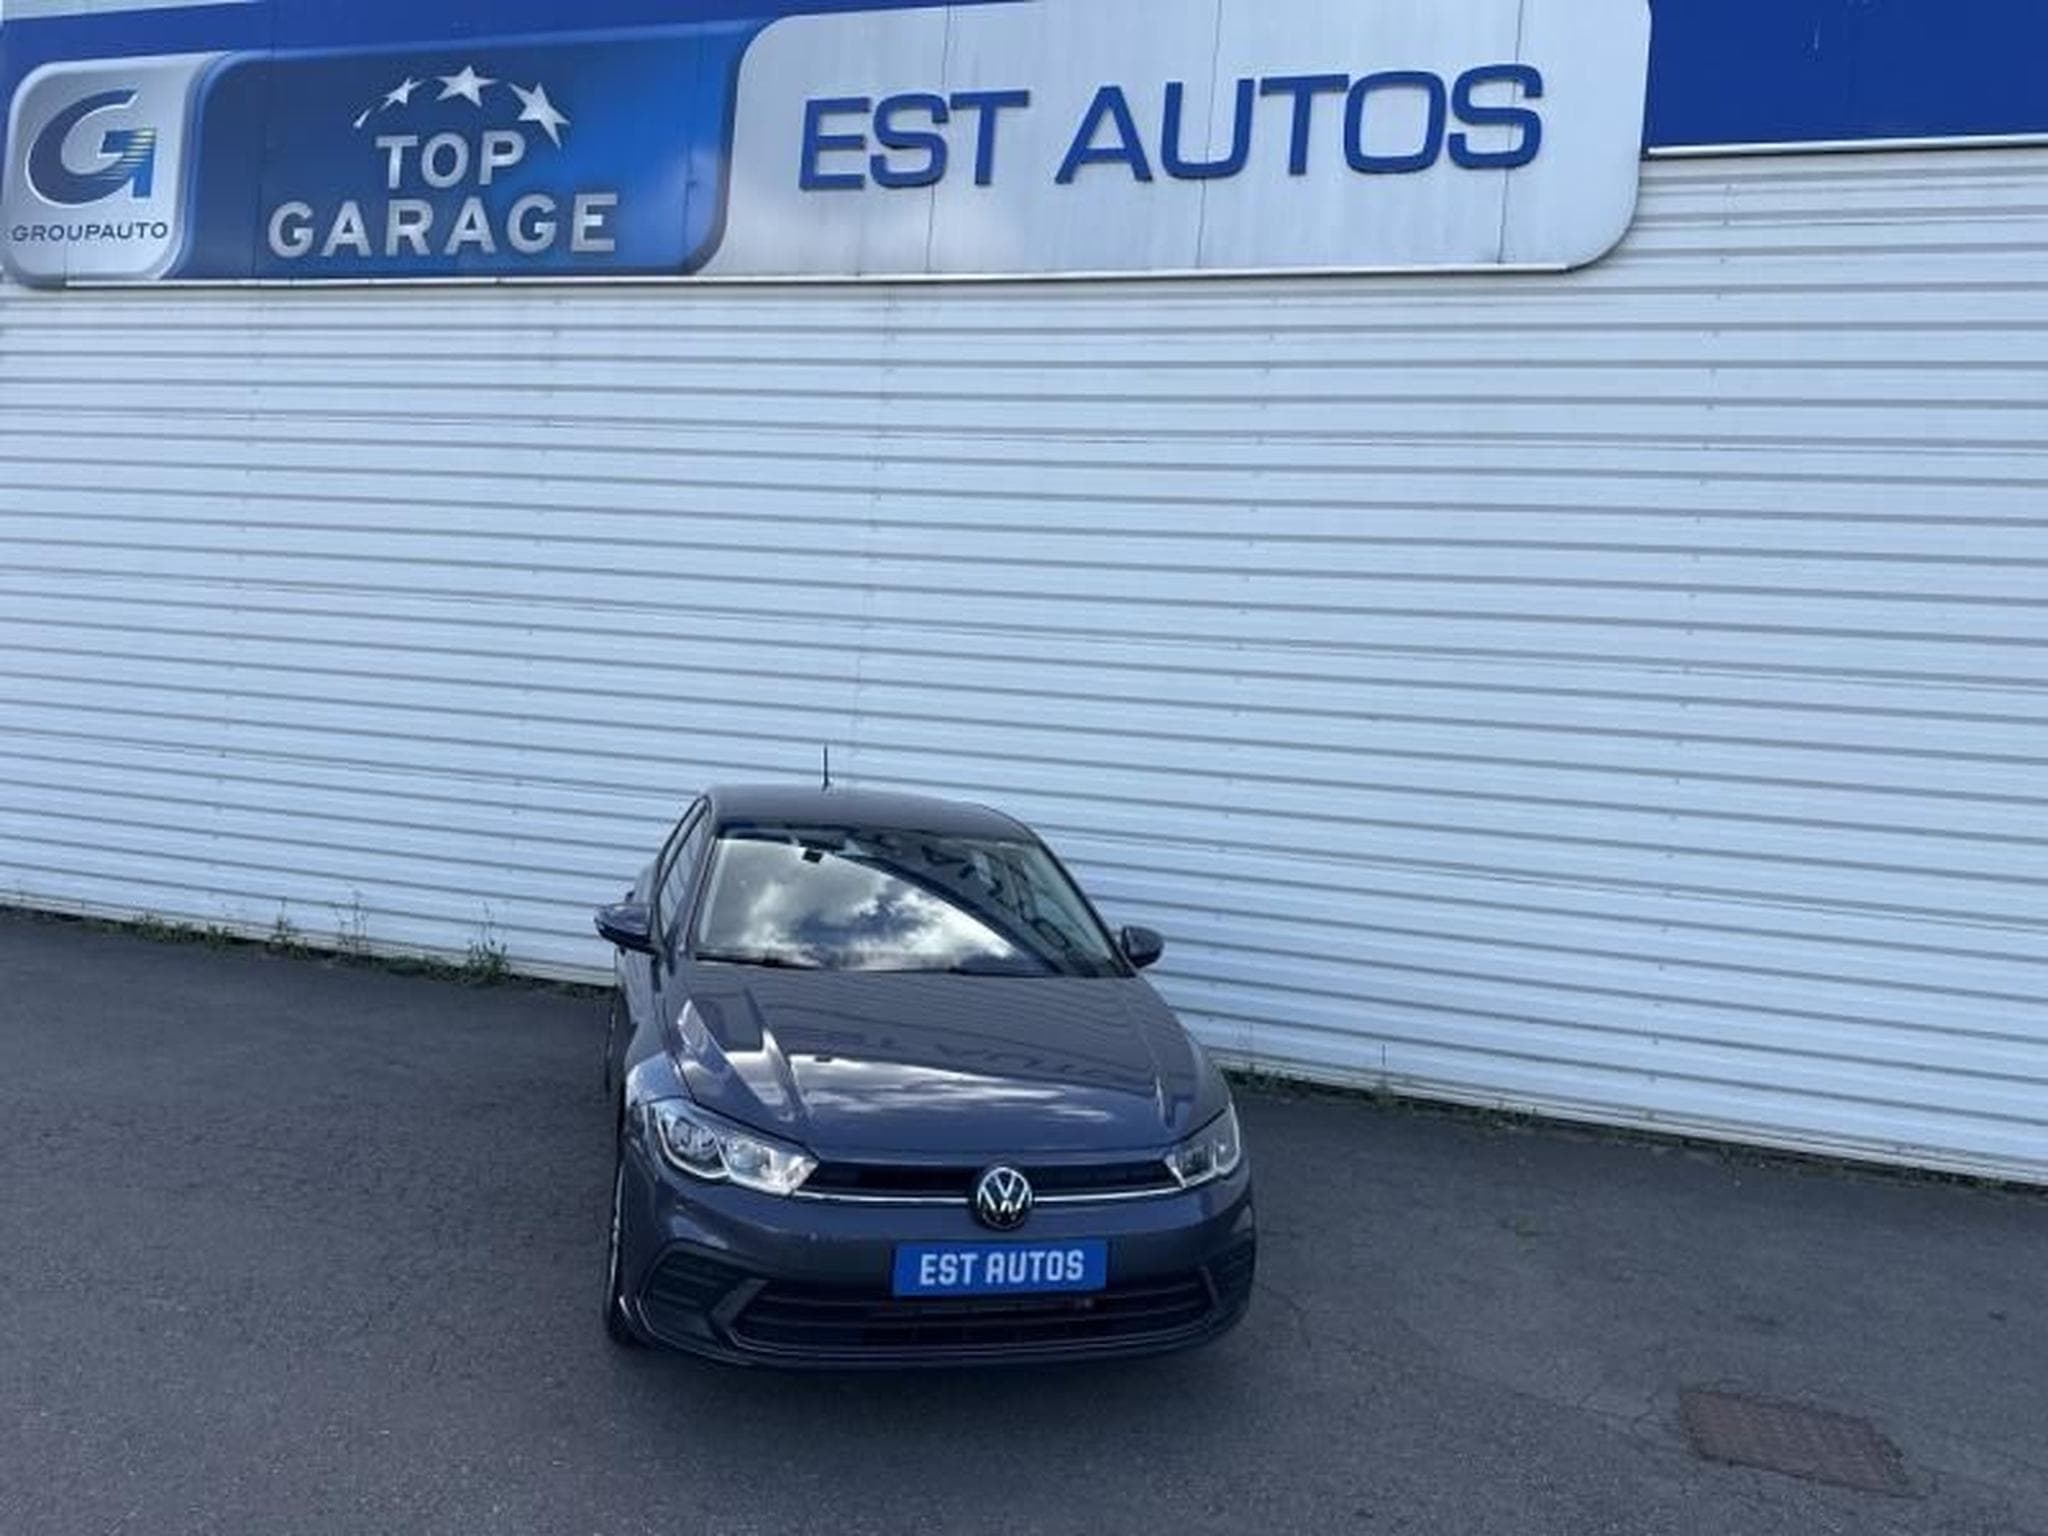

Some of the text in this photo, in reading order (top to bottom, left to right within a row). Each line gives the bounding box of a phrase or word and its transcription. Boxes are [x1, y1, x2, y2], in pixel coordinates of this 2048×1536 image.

[798, 63, 1544, 191] EST AUTOS
[375, 129, 526, 190] TOP
[11, 221, 169, 244] GROUPAUTO
[267, 192, 618, 259] GARAGE
[920, 1249, 1086, 1286] EST AUTOS
